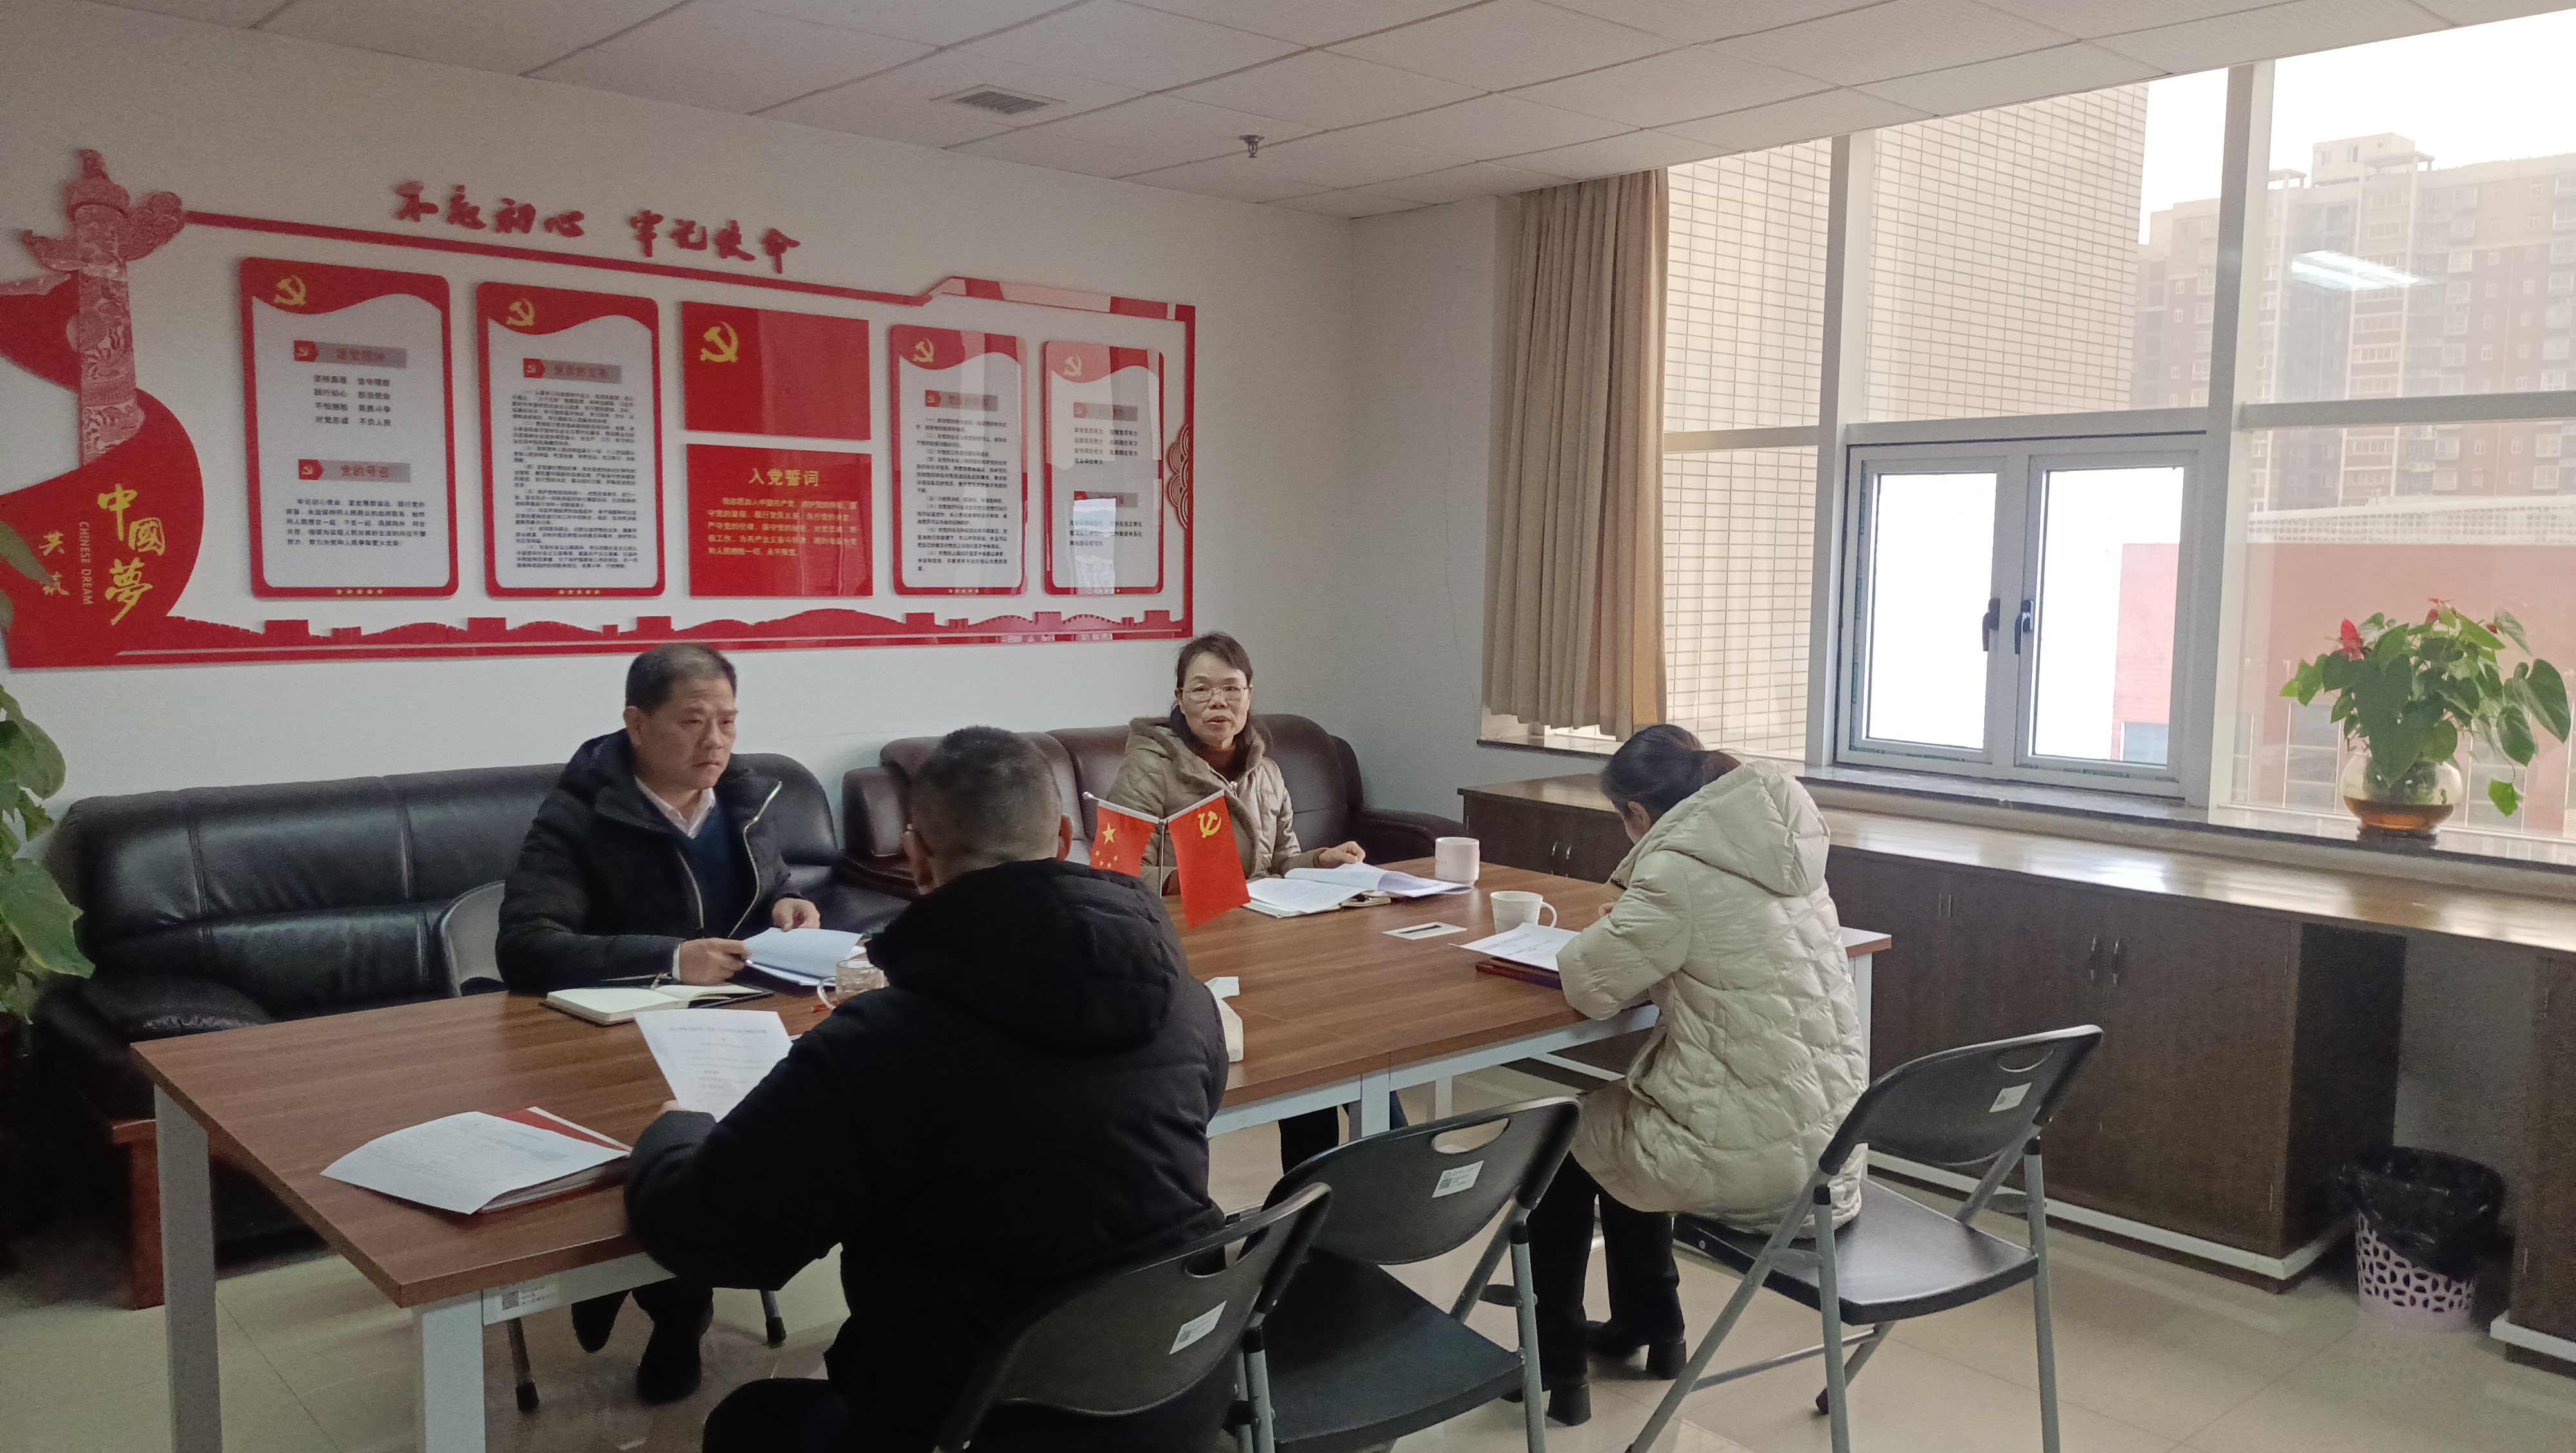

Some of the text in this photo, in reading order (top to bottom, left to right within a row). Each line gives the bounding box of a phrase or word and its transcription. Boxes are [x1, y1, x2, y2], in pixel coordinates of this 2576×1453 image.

[393, 180, 800, 274] 不忘初心 牢记使命
[748, 467, 820, 488] 入党誓词
[79, 520, 94, 605] CHINESE DREAM
